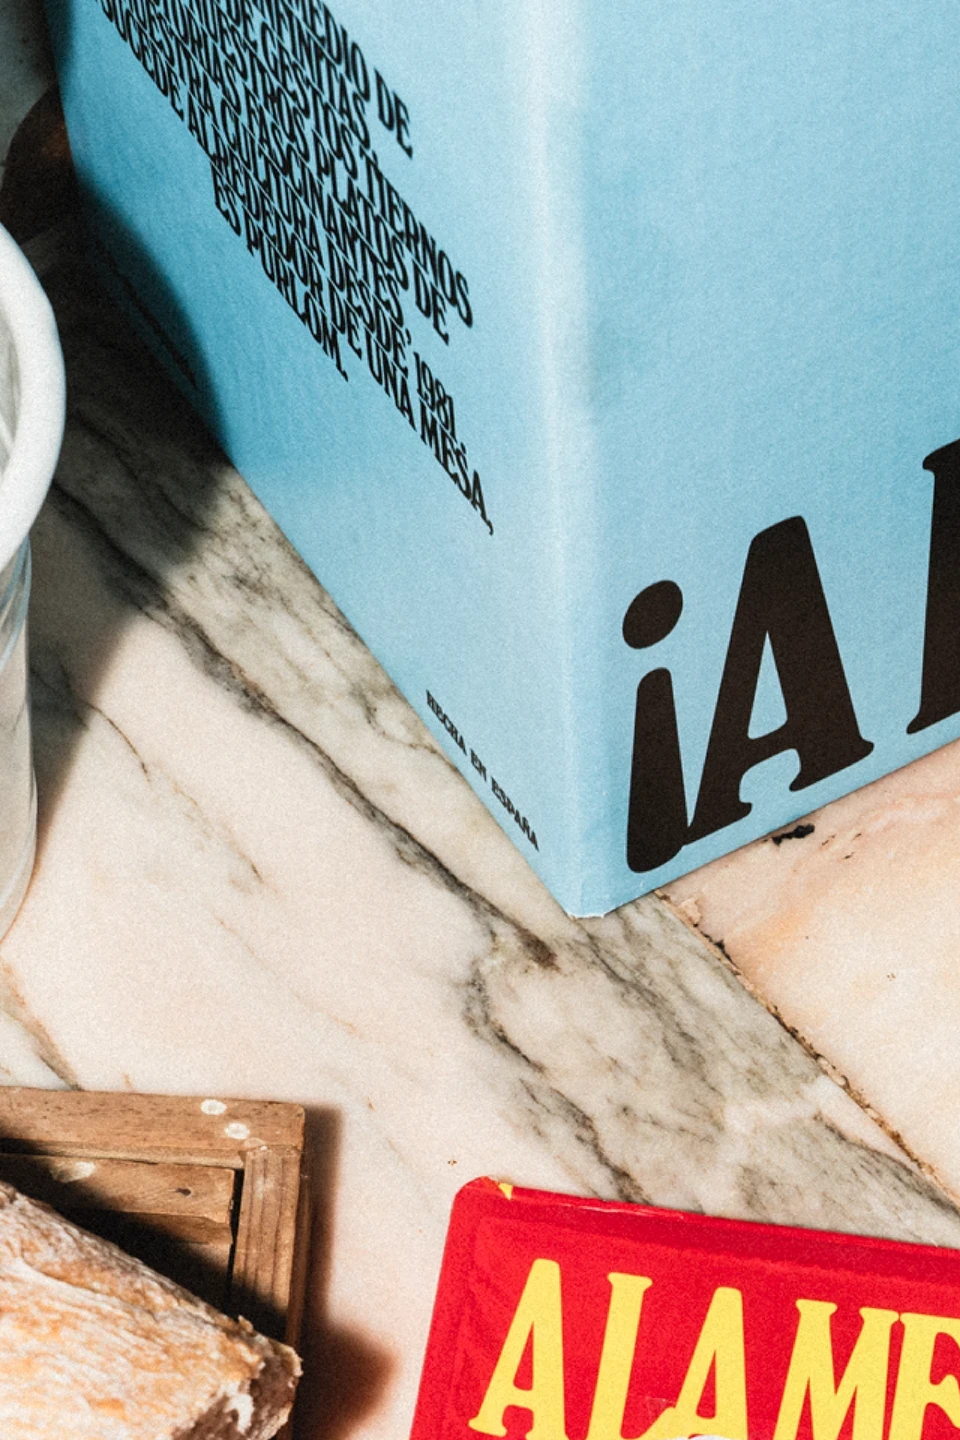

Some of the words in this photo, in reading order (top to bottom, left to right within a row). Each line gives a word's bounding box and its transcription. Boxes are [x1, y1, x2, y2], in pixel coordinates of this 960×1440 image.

[128, 0, 220, 130] UESTRA
[220, 98, 325, 270] CULTURA
[325, 235, 409, 378] DESDE
[242, 83, 412, 344] FASCINANTES,
[260, 21, 358, 180] GESTOS
[359, 145, 473, 328] TIERNOS
[375, 70, 413, 158] DE
[187, 92, 326, 312] ALREDEDOR
[327, 279, 362, 360] DE
[364, 327, 416, 431] UNA
[419, 399, 494, 536] MESA,
[210, 164, 242, 237] ES
[241, 205, 349, 382] PURLOM.
[311, 130, 409, 291] PLATOS
[412, 260, 449, 345] DE
[426, 689, 467, 756] HECHA
[470, 747, 487, 783] EN
[491, 776, 540, 852] ESPAÑA
